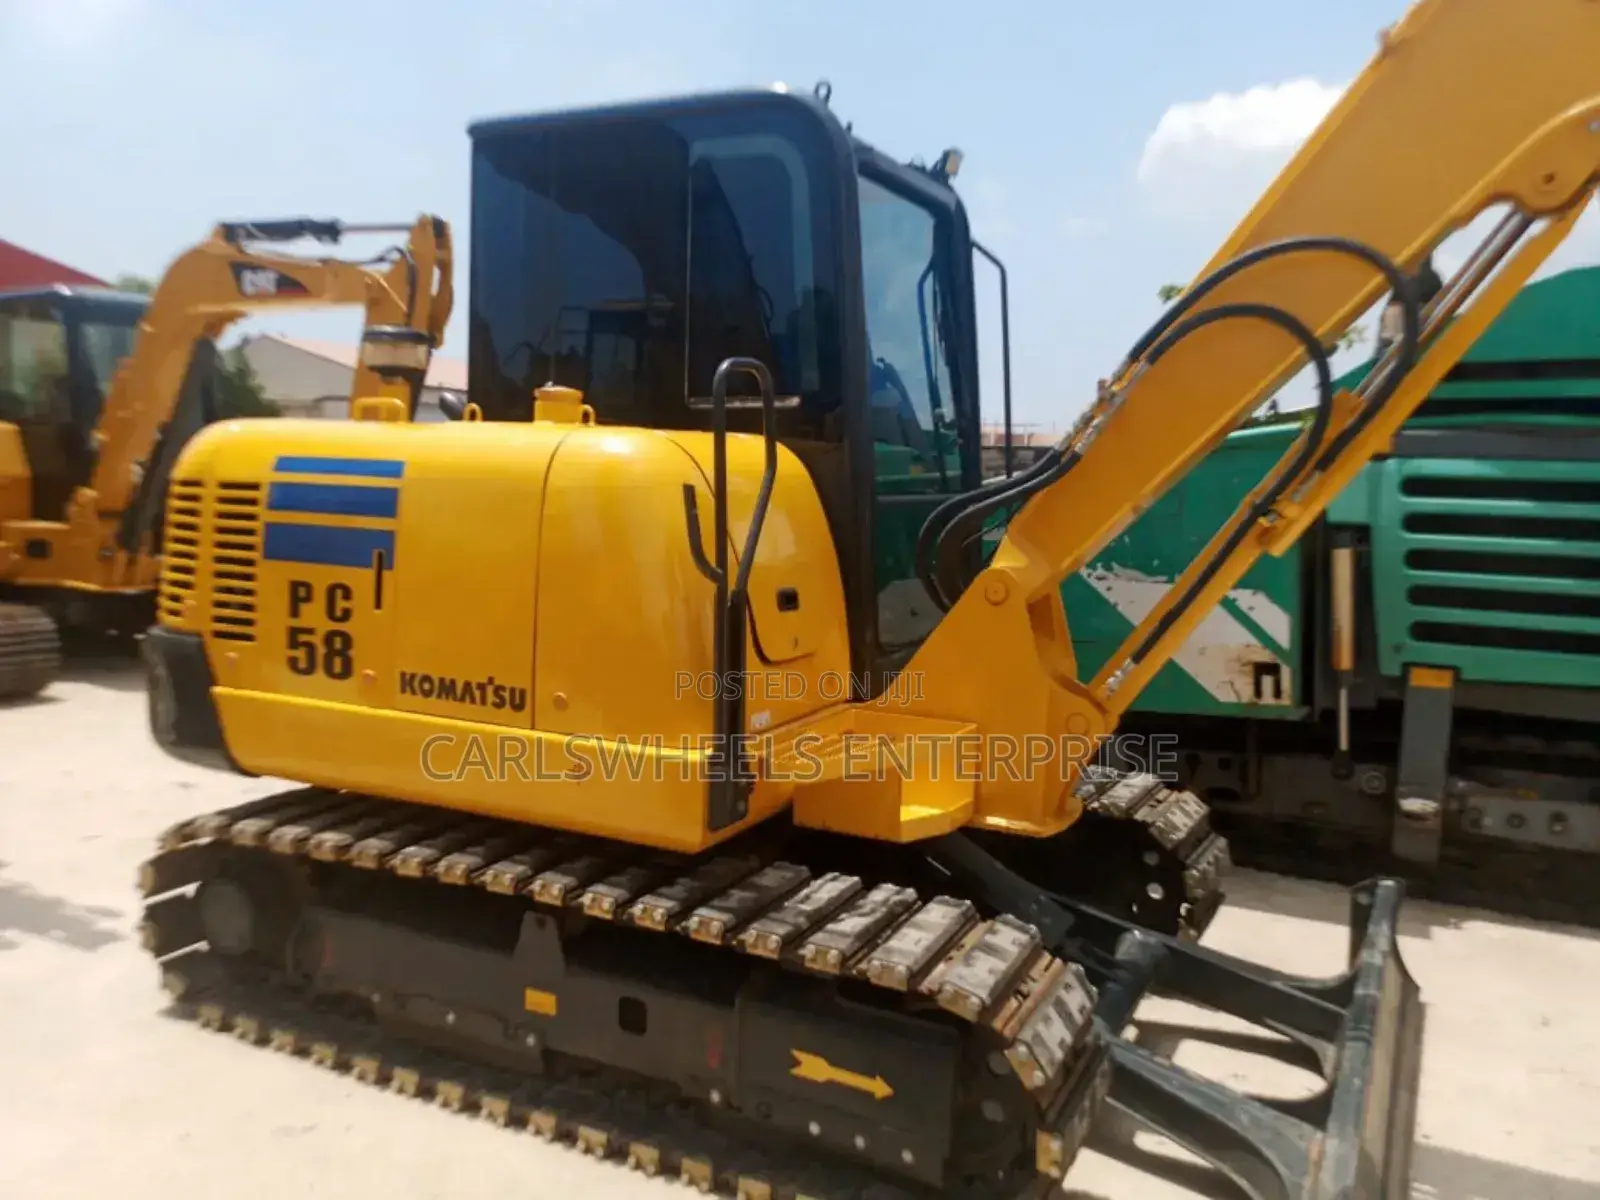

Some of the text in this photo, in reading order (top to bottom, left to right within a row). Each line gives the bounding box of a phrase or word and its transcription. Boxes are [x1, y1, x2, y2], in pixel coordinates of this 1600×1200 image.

[288, 580, 353, 623] PC
[286, 626, 354, 680] 58
[399, 670, 527, 713] KOMATSU
